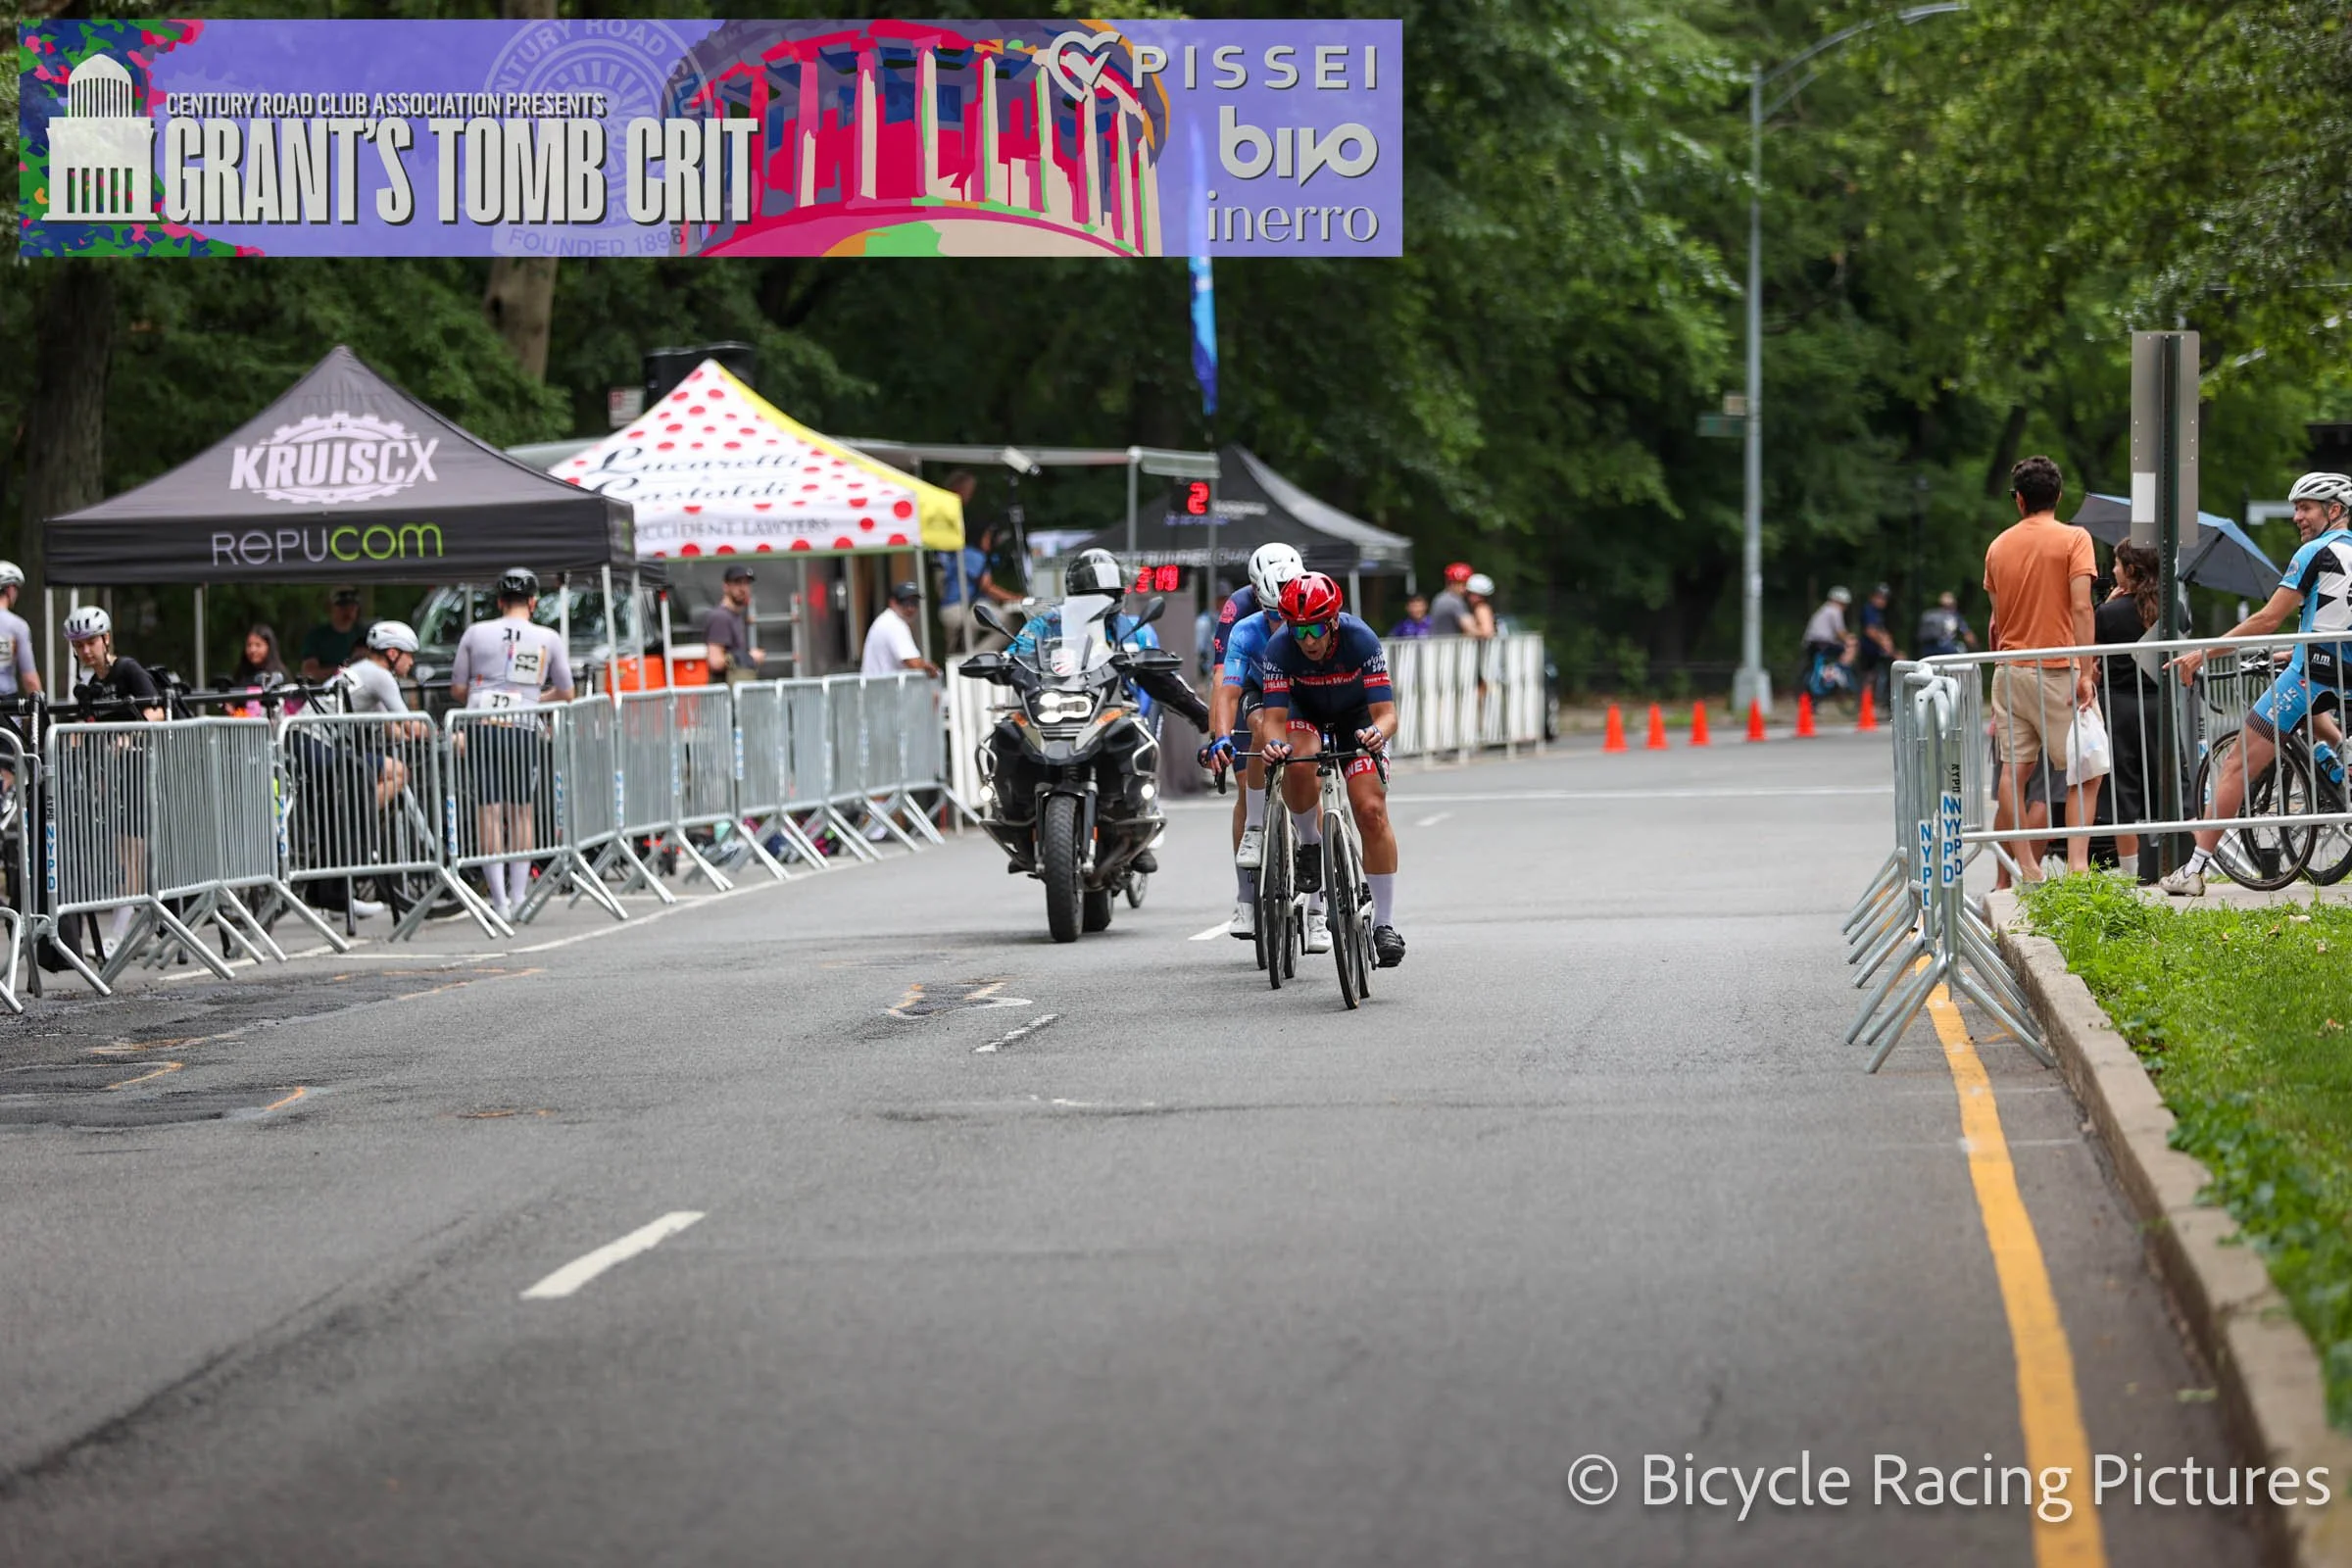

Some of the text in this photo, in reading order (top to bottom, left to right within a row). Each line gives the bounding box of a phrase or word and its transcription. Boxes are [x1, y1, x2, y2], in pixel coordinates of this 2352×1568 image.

[229, 437, 440, 490] KRUISCX
[635, 523, 739, 540] CCIDENT
[46, 825, 56, 890] NYPD
[1943, 796, 1954, 882] NYPD
[1953, 798, 1962, 875] NYPD
